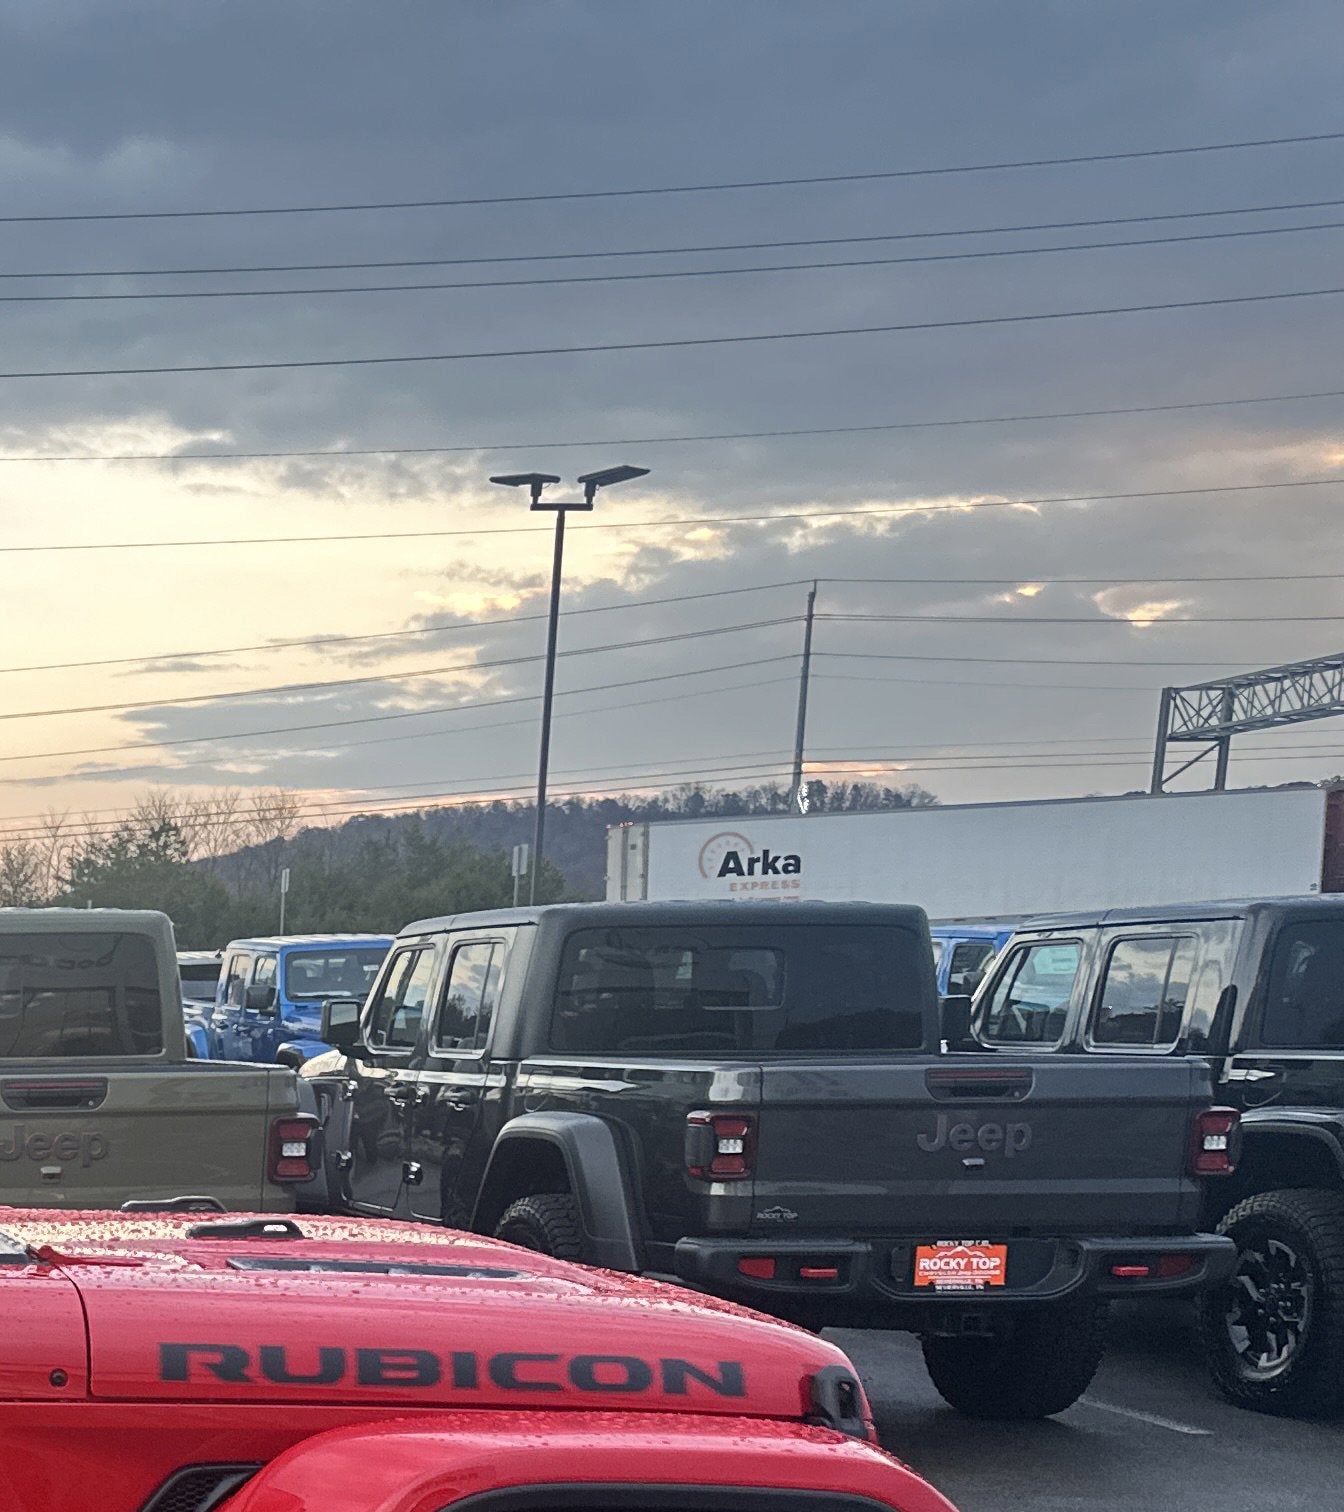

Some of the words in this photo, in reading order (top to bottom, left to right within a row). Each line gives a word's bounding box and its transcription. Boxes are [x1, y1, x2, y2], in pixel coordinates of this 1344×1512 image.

[717, 849, 801, 878] Arka
[729, 880, 801, 892] EXPRESS
[917, 1113, 1032, 1158] Jeep
[919, 1258, 968, 1270] ROCKY
[970, 1257, 1001, 1269] TOP
[157, 1342, 746, 1398] RUBICON
